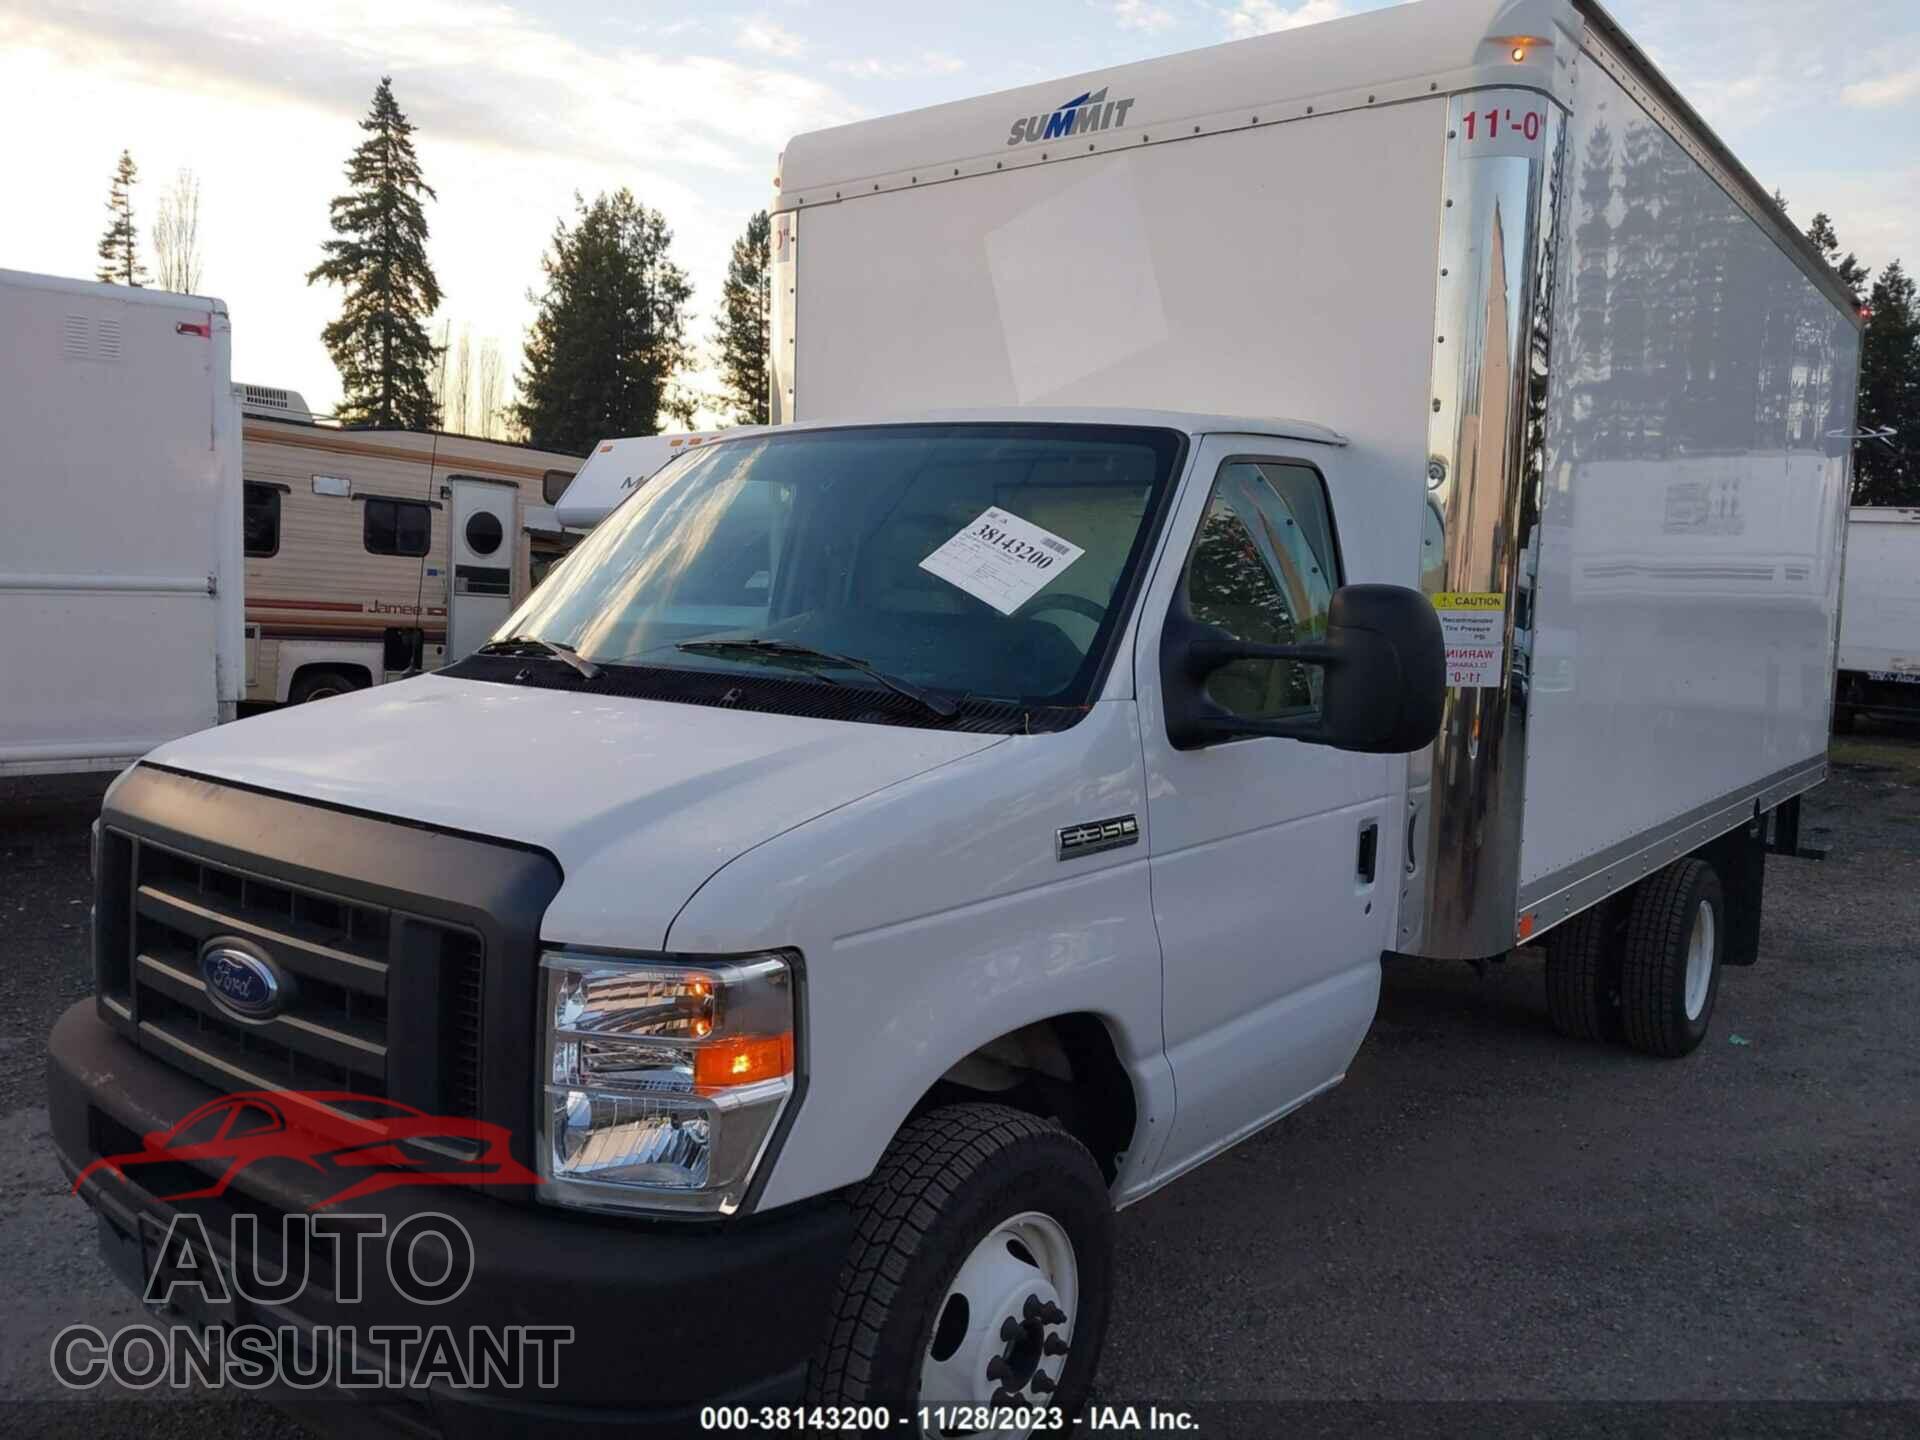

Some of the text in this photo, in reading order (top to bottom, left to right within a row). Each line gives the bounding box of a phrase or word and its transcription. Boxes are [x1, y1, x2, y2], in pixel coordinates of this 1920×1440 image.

[1007, 97, 1135, 146] SUMMIT
[972, 523, 1054, 570] 38143200
[1455, 596, 1501, 606] CAUTION
[213, 957, 253, 998] Ford
